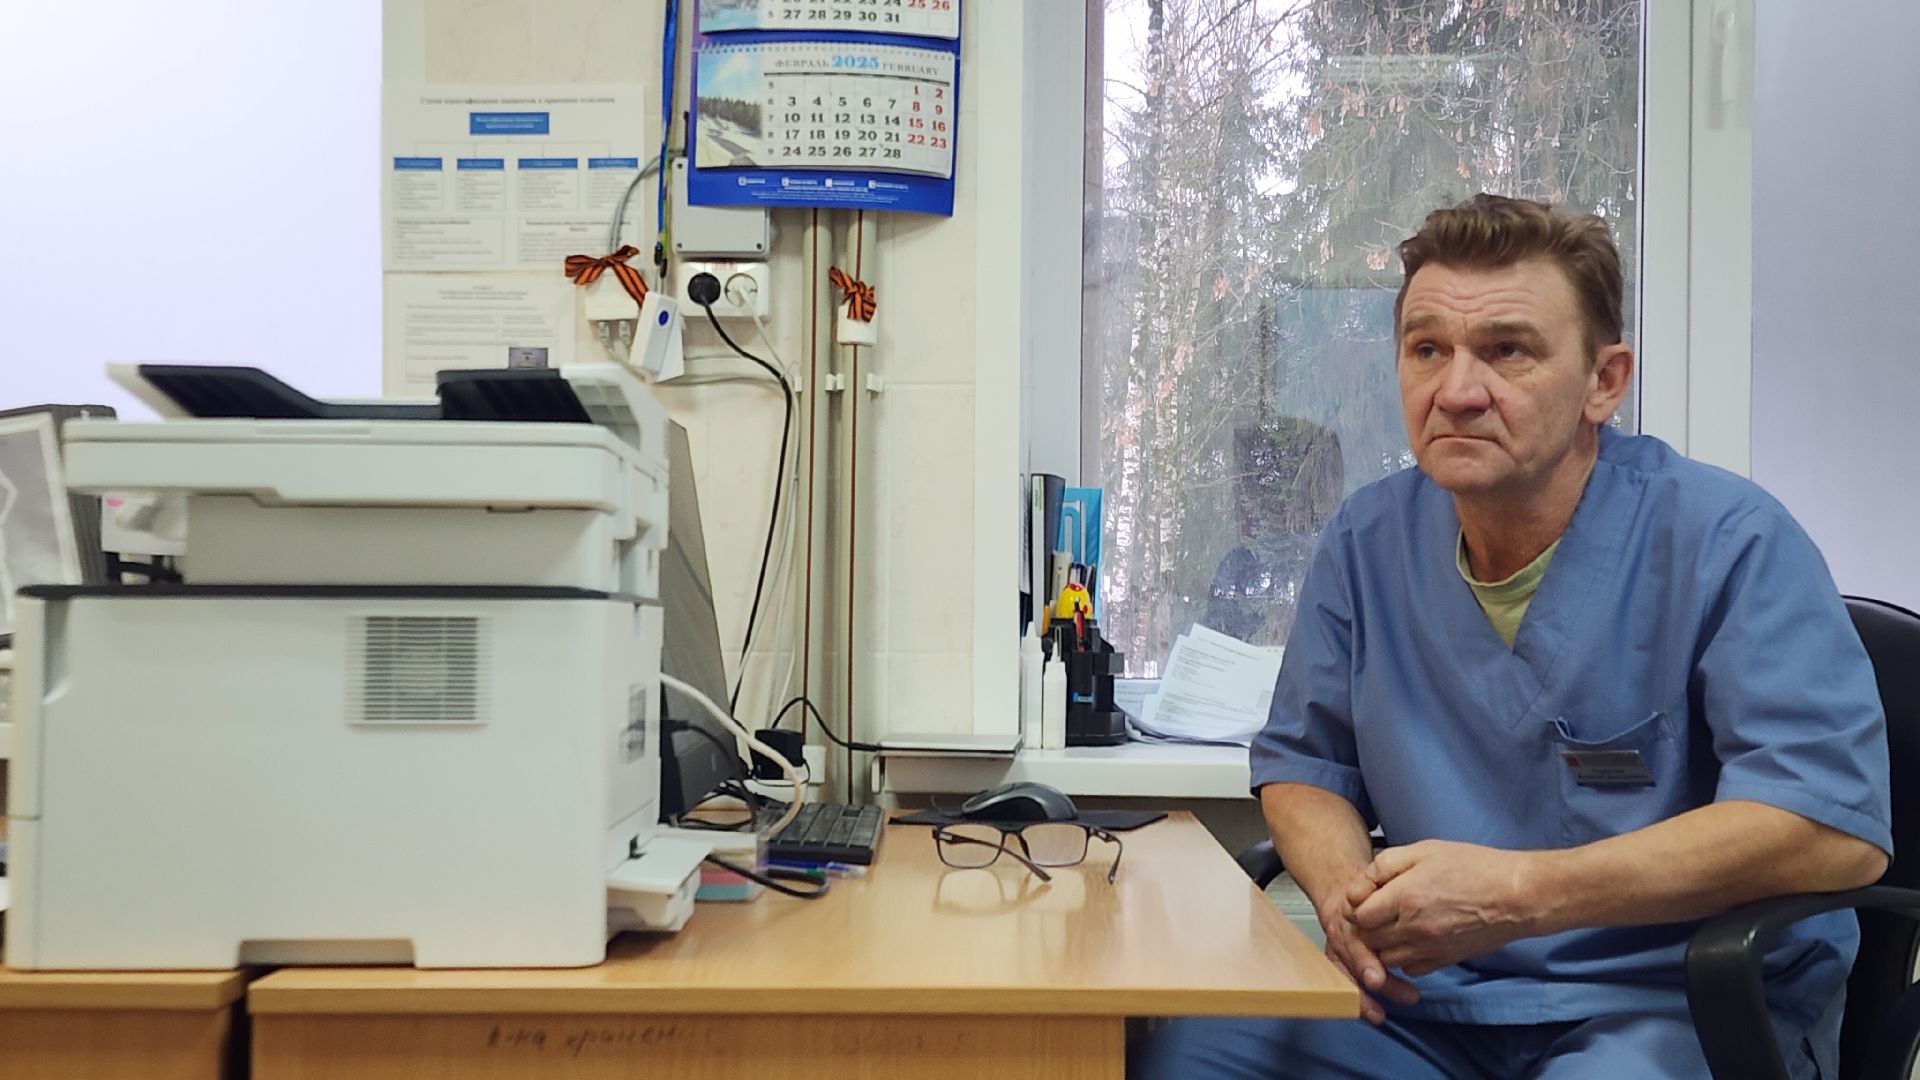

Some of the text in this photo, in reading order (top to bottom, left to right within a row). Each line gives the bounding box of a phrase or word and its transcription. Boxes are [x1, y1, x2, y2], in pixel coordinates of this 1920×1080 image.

[932, 0, 950, 11] 26
[783, 9, 801, 20] 27
[808, 10, 826, 20] 28
[833, 10, 851, 20] 29
[858, 11, 877, 22] 30
[884, 12, 899, 23] 31
[775, 56, 939, 76] ФЕВРАЛЬ 2025 FEBRUARY
[935, 88, 943, 99] 2
[788, 97, 796, 107] 3
[813, 97, 821, 106] 4
[838, 97, 847, 107] 5
[863, 98, 871, 107] 6
[888, 99, 896, 109] 7
[912, 102, 920, 112] 8
[784, 113, 800, 123] 10
[811, 113, 823, 123] 11
[835, 113, 850, 123] 12
[860, 114, 875, 124] 13
[885, 115, 900, 125] 14
[909, 118, 923, 128] 15
[932, 121, 946, 132] 16
[785, 130, 799, 139] 17
[810, 130, 825, 140] 18
[835, 130, 850, 140] 19
[858, 131, 877, 141] 20
[884, 132, 899, 142] 21
[908, 134, 925, 145] 22
[931, 137, 946, 148] 23
[782, 147, 801, 157] 24
[808, 147, 826, 157] 25
[833, 147, 852, 157] 26
[859, 148, 877, 157] 27
[883, 149, 901, 159] 28
